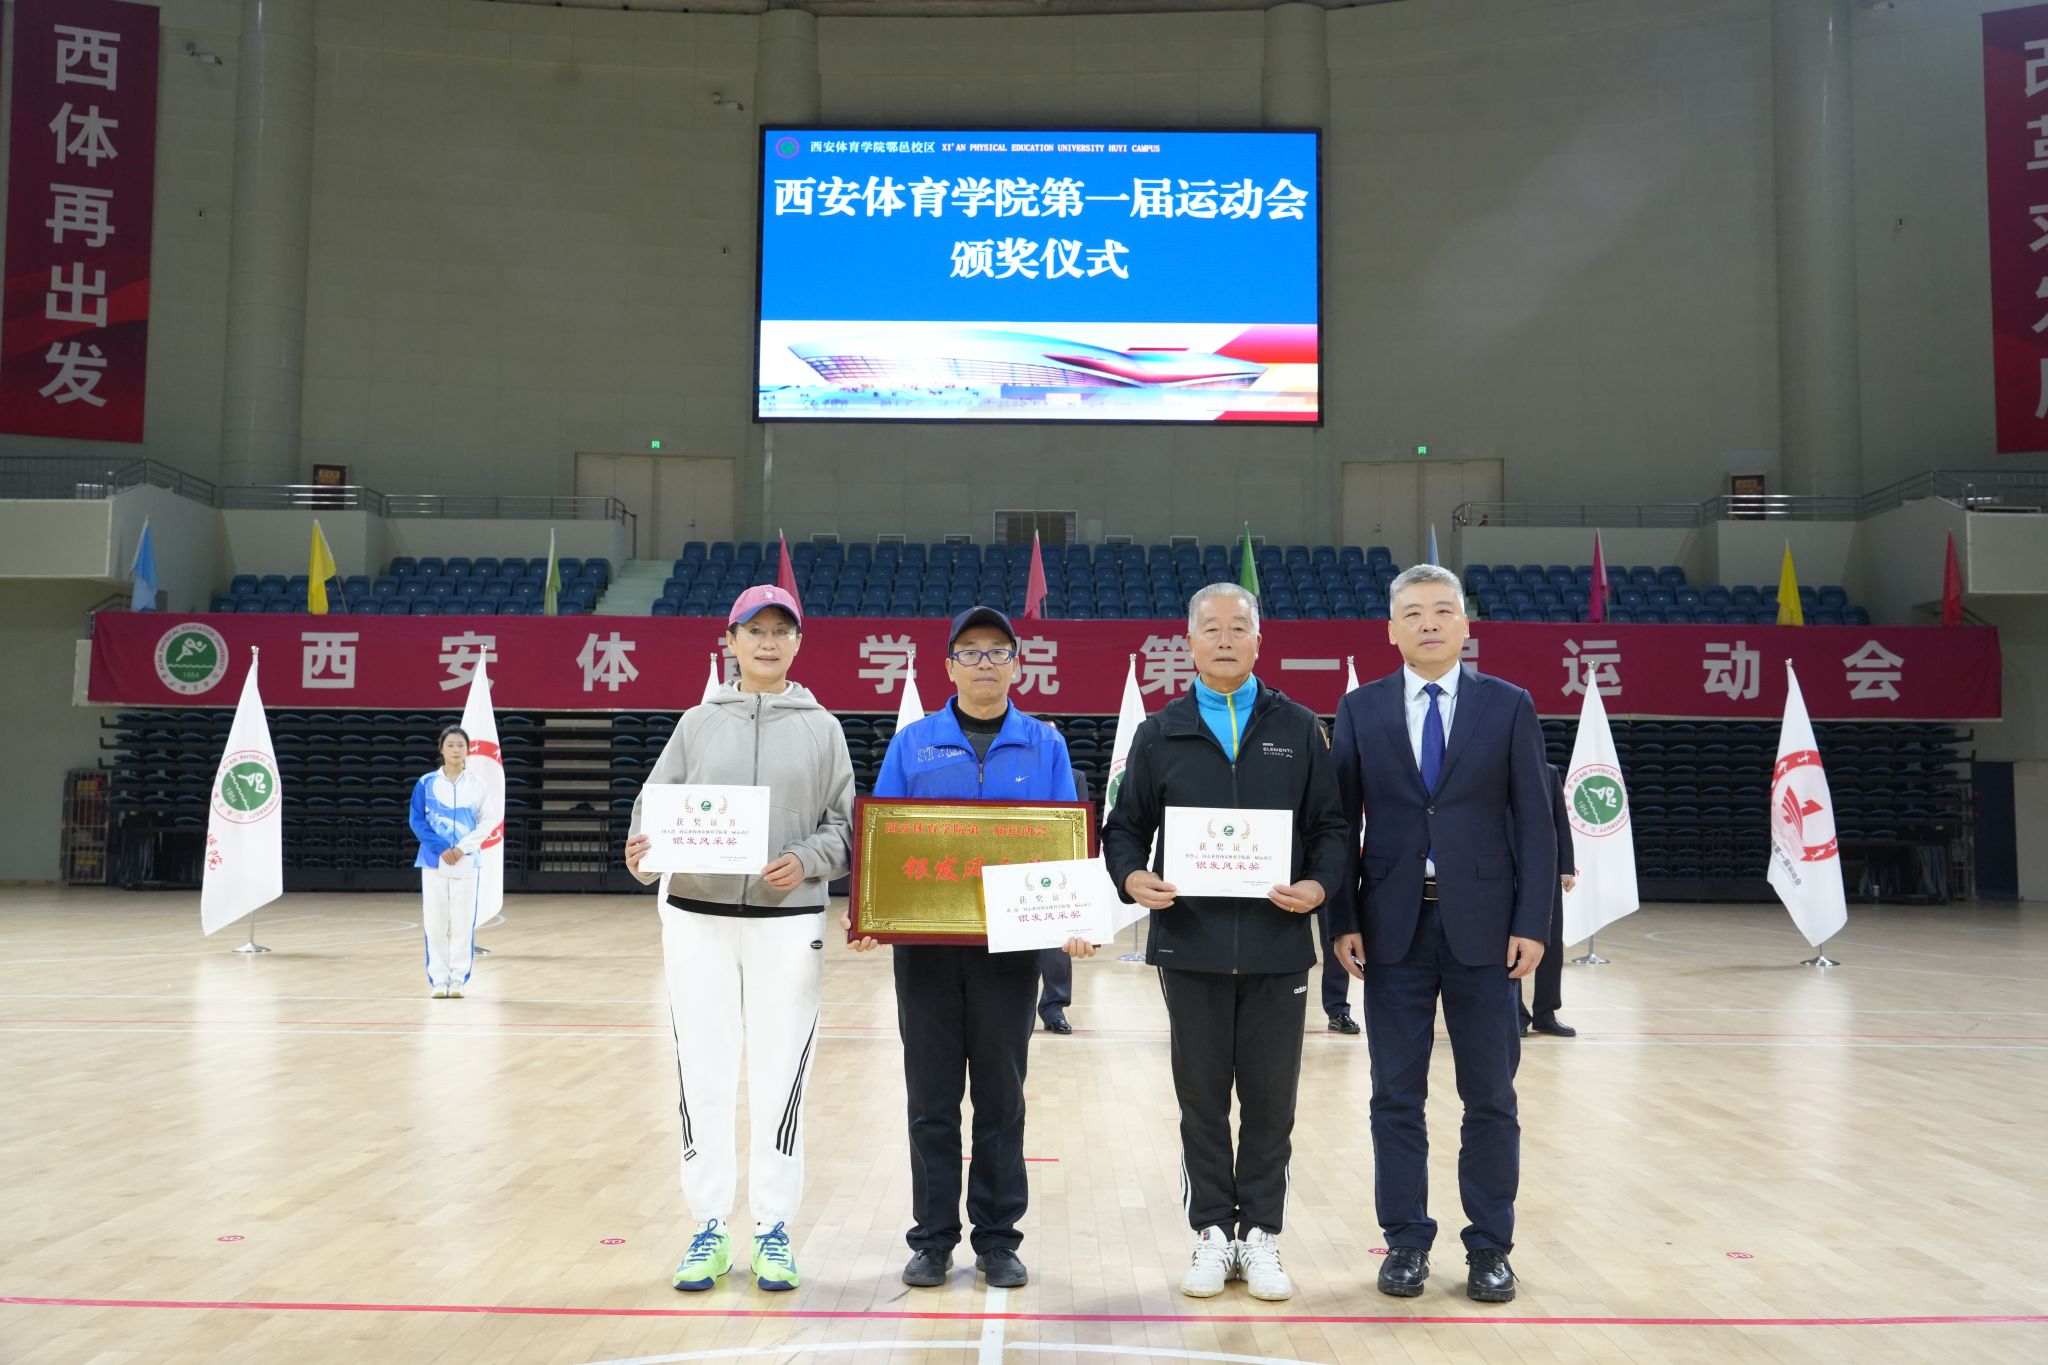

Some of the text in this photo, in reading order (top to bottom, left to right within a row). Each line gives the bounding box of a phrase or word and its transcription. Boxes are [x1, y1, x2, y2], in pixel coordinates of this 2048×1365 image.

[942, 143, 1161, 153] XI'AN PHYSICAL EDUCATION UNIVERSITY HUYI CAMPUS
[39, 24, 121, 408] 西体再出发
[774, 176, 1309, 220] 西安体育学院第一届运动会
[949, 238, 1130, 280] 颁奖仪式
[884, 822, 1048, 837] 西安体育学院第届运动会
